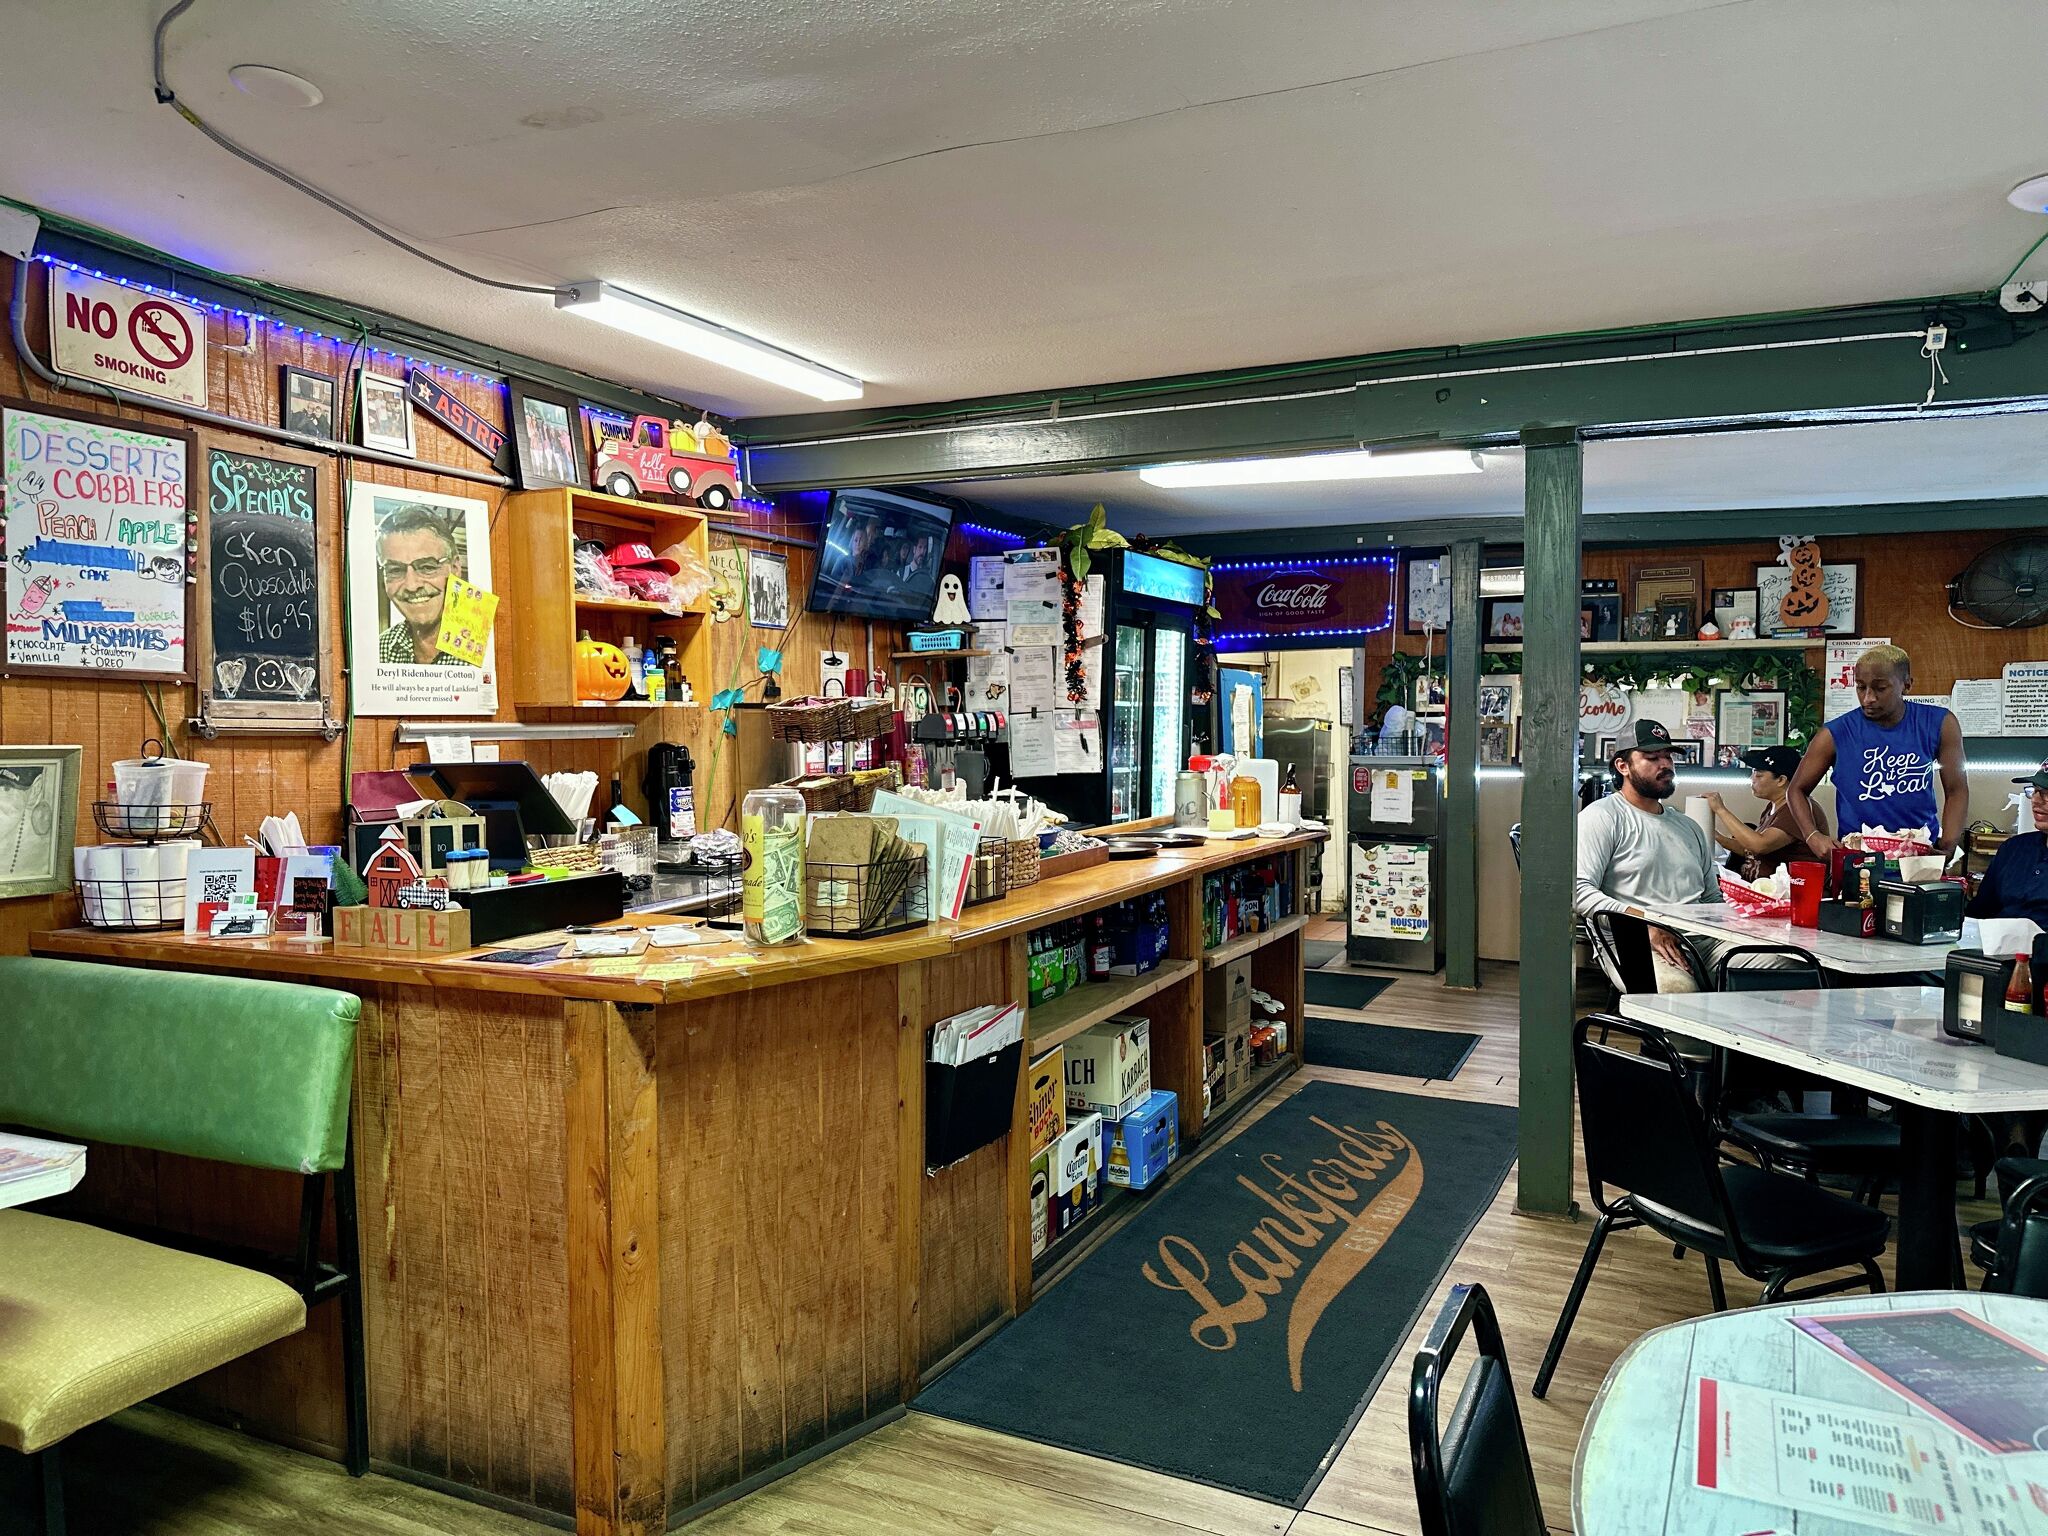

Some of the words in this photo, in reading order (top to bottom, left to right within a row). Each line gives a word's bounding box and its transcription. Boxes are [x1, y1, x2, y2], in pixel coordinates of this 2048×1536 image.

[66, 292, 118, 339] NO
[94, 353, 167, 385] SMOKING
[21, 428, 183, 482] DESSERTS
[640, 452, 666, 470] hello
[641, 468, 665, 481] FALL
[53, 469, 185, 508] COBBLERS
[36, 500, 97, 541] PEACH
[119, 517, 178, 545] APPLE
[80, 569, 110, 582] CAKE
[219, 562, 315, 602] Quesadilla
[138, 611, 178, 621] COBBLER
[237, 599, 312, 643] $16.95
[42, 620, 169, 651] MILKSHAKES
[17, 640, 66, 651] CHOCOLATE
[90, 644, 137, 661] Strawberry
[95, 657, 124, 668] OREO
[376, 668, 399, 679] Deryl
[401, 670, 442, 679] Ridenhour
[444, 671, 476, 680] (Cotton)
[2009, 669, 2048, 677] NOTICE
[396, 685, 415, 694] always
[430, 686, 444, 694] part
[1579, 694, 1626, 718] lcome
[1862, 746, 1921, 776] Keep
[1886, 768, 1897, 781] it
[340, 913, 444, 948] FALL
[1390, 917, 1428, 929] HOUSTON
[1121, 1048, 1148, 1099] KARBACH
[1067, 1090, 1086, 1098] TEXAS
[1135, 1080, 1149, 1098] LAGER
[1033, 1109, 1054, 1140] BOCK
[1066, 1154, 1088, 1178] Corona
[1108, 1165, 1129, 1174] Modelo
[1071, 1170, 1083, 1183] Extra
